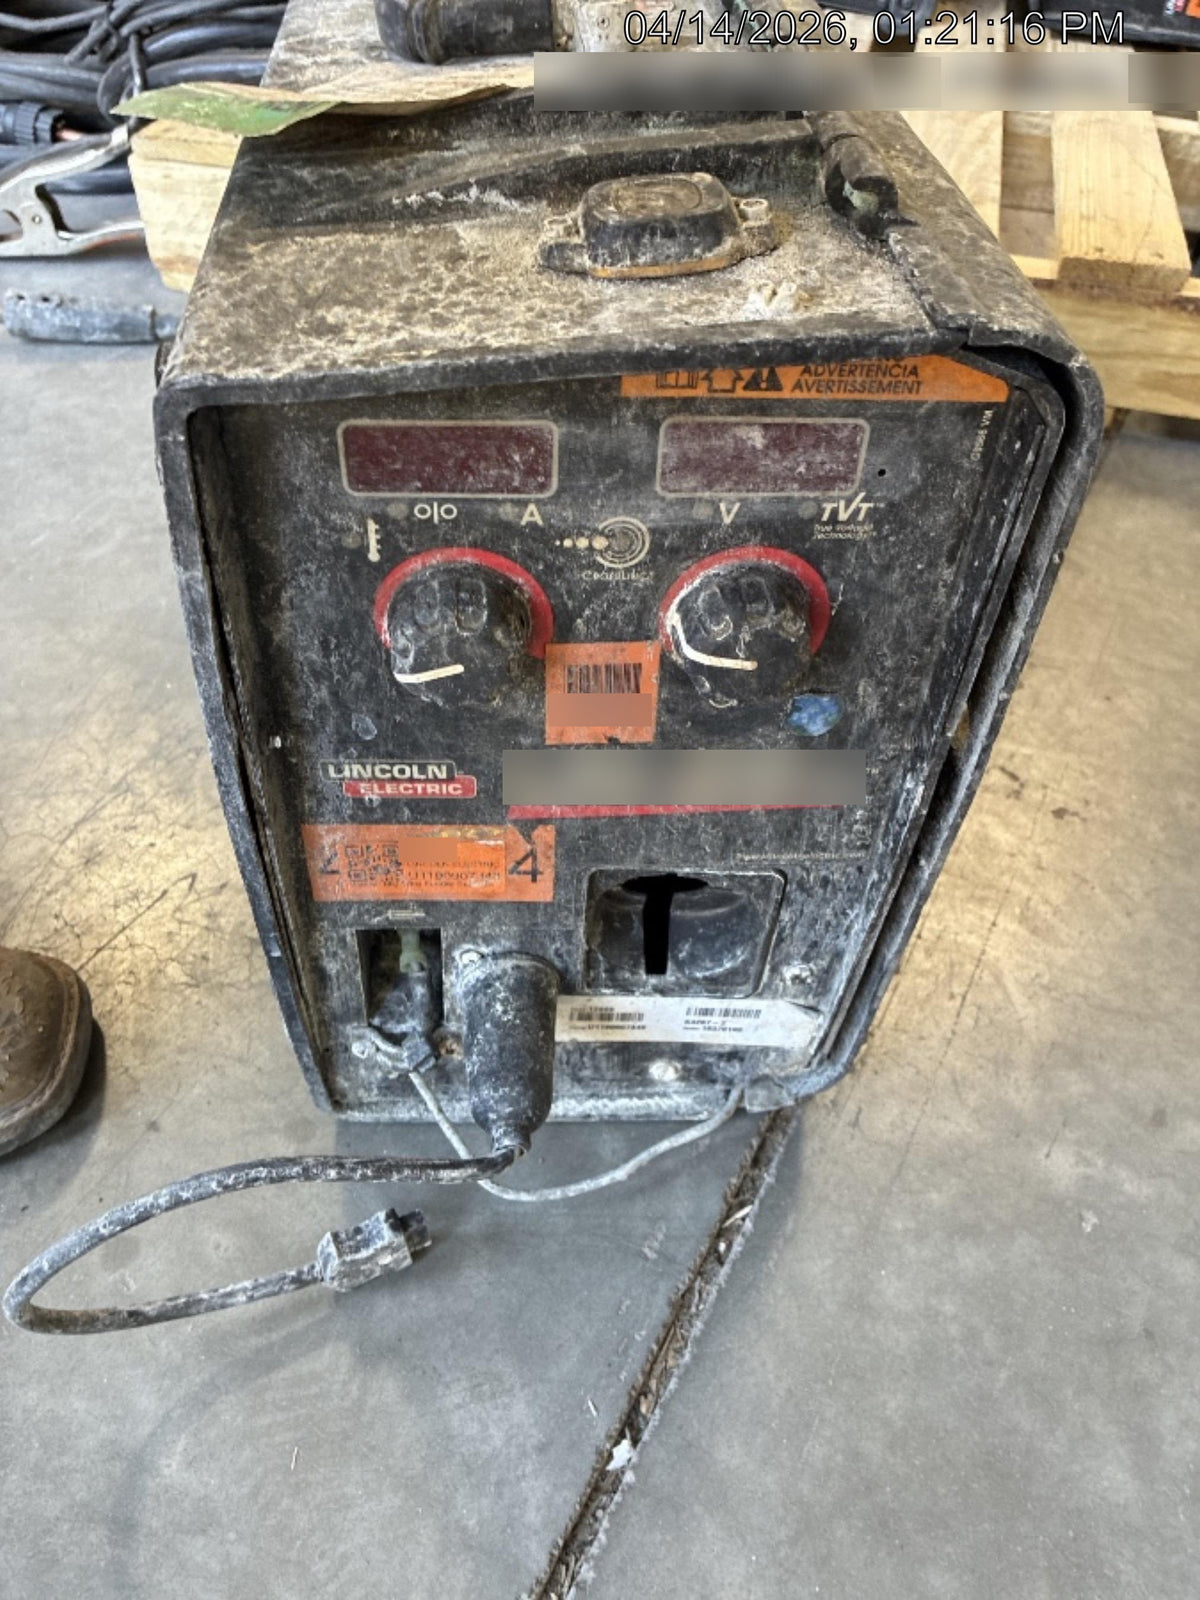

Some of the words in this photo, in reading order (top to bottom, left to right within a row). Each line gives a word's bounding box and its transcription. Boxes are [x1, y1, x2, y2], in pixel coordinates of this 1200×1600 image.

[801, 362, 919, 378] ADVERTENCIA
[791, 377, 922, 395] AVERTISSEMENT
[520, 503, 544, 527] A
[719, 502, 741, 525] V
[820, 492, 874, 522] TVT
[327, 763, 448, 780] LINCOLN
[359, 782, 463, 796] ELECTRIC
